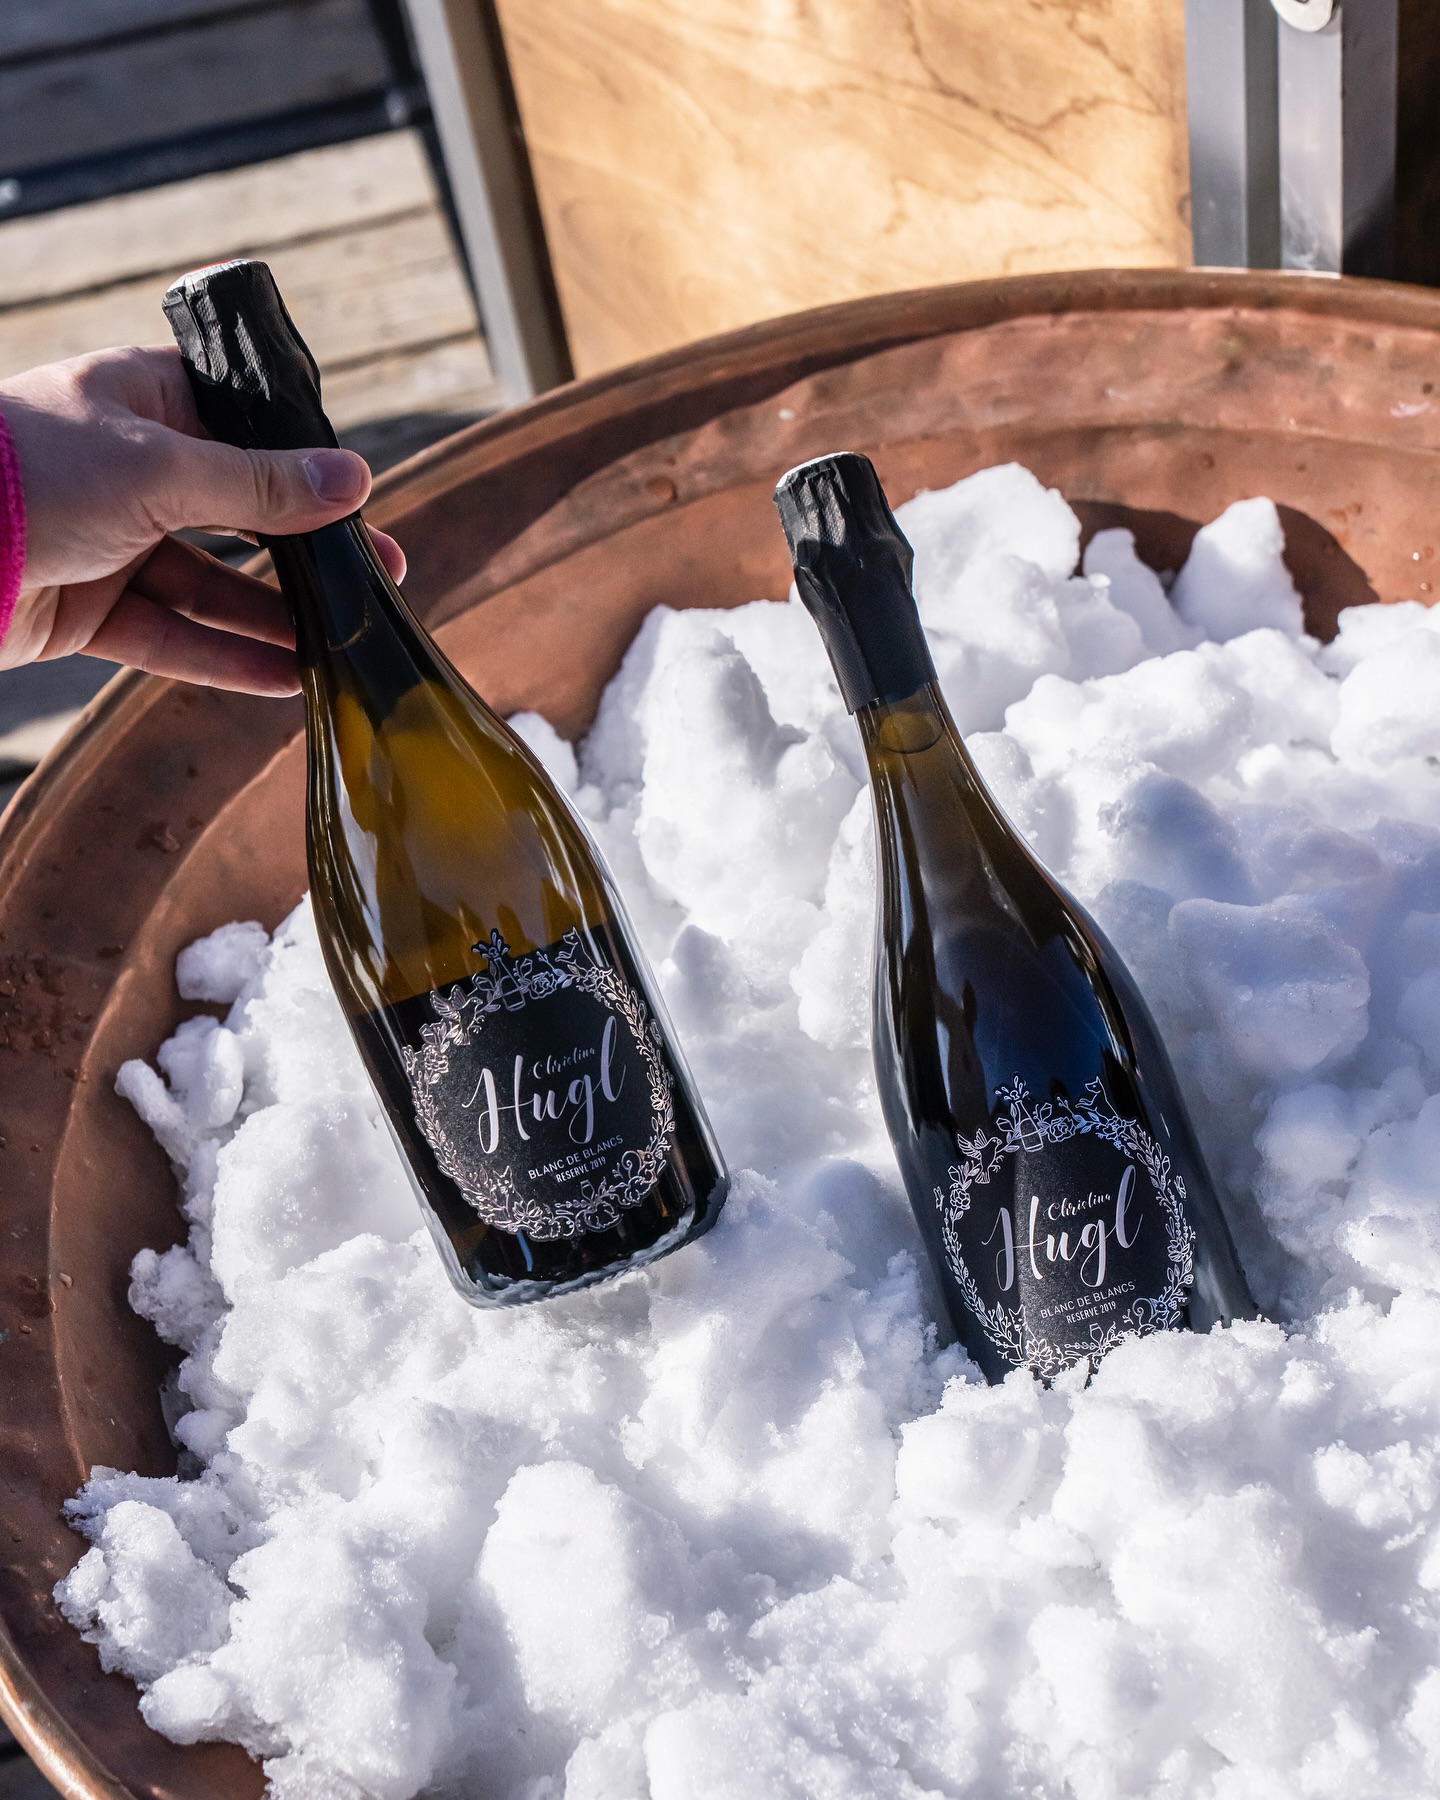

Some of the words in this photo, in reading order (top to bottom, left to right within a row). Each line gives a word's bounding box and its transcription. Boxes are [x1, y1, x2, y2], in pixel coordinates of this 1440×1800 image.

[461, 1015, 626, 1154] Hugl
[528, 1158, 564, 1179] BLANC
[565, 1152, 581, 1166] DE
[583, 1135, 624, 1159] BLANCS
[556, 1165, 590, 1183] RESERVE
[590, 1156, 607, 1172] 2019
[1045, 1192, 1111, 1221] Christina
[981, 1165, 1143, 1291] Hugl
[1040, 1301, 1074, 1319] BLANC
[1077, 1295, 1092, 1308] DE
[1094, 1281, 1136, 1303] BLANCS
[1066, 1307, 1099, 1324] RESERVE
[1100, 1301, 1117, 1316] 2019
